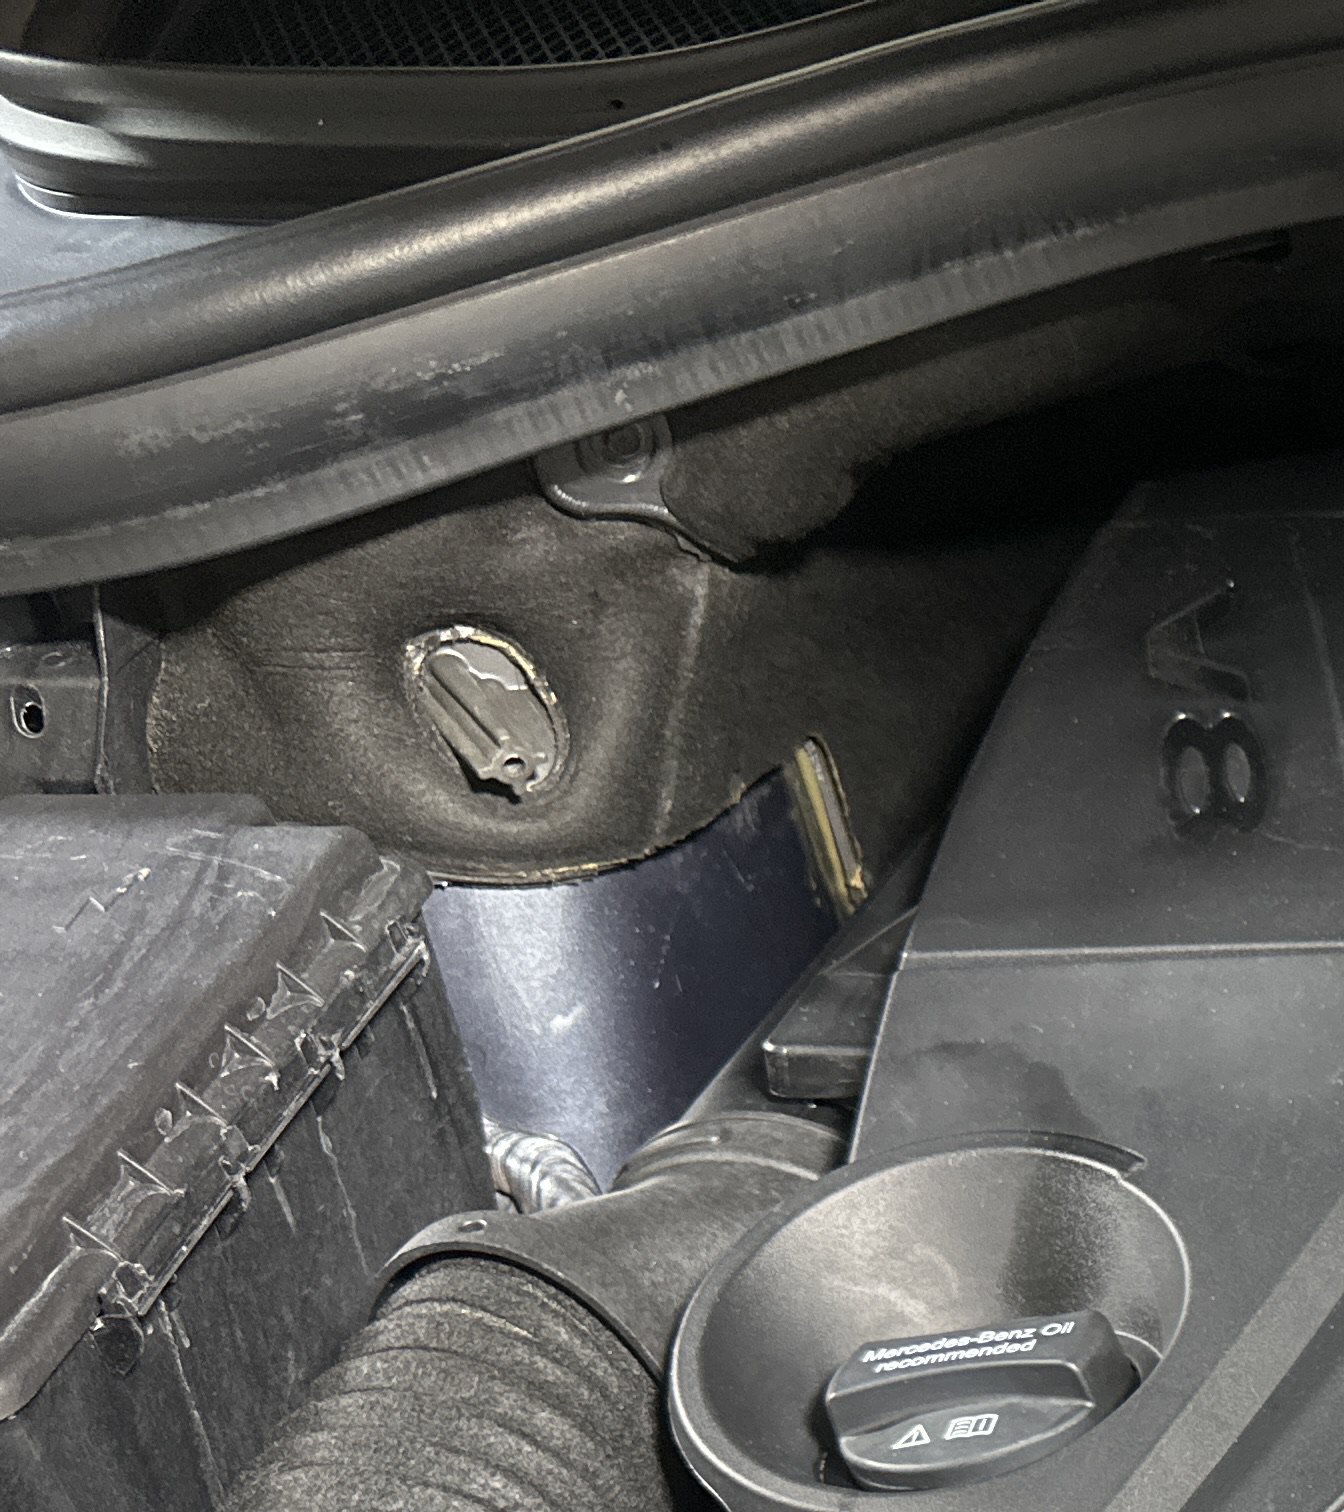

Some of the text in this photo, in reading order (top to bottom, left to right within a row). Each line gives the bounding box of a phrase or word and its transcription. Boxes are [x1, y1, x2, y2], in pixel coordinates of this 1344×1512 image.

[1145, 578, 1268, 842] V8
[862, 1320, 1076, 1363] Mercedes-Benz Oil
[874, 1338, 1037, 1373] recommended
